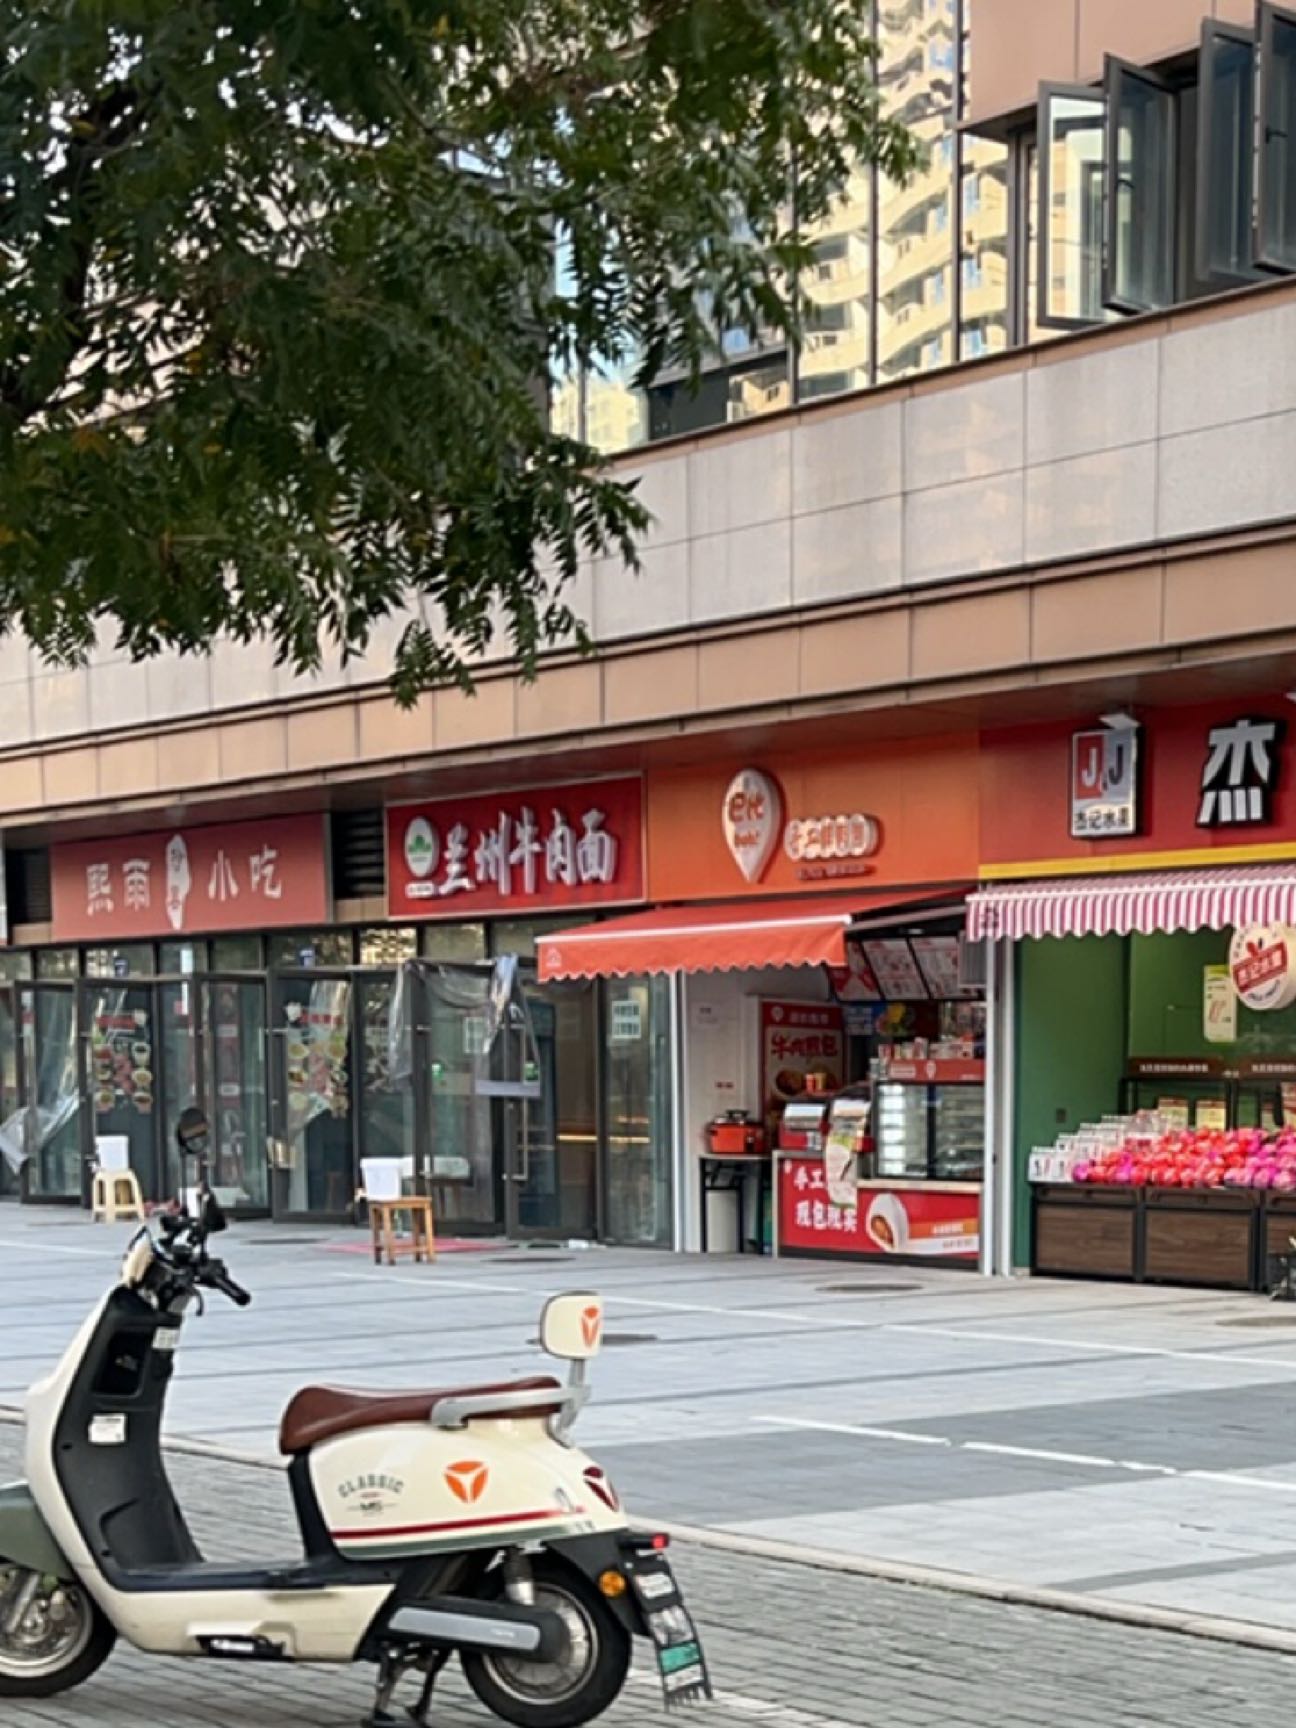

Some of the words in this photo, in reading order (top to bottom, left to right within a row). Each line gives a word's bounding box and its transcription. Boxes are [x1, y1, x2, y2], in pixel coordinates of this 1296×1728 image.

[207, 843, 282, 902] 小吃
[437, 805, 617, 895] 兰州牛肉面
